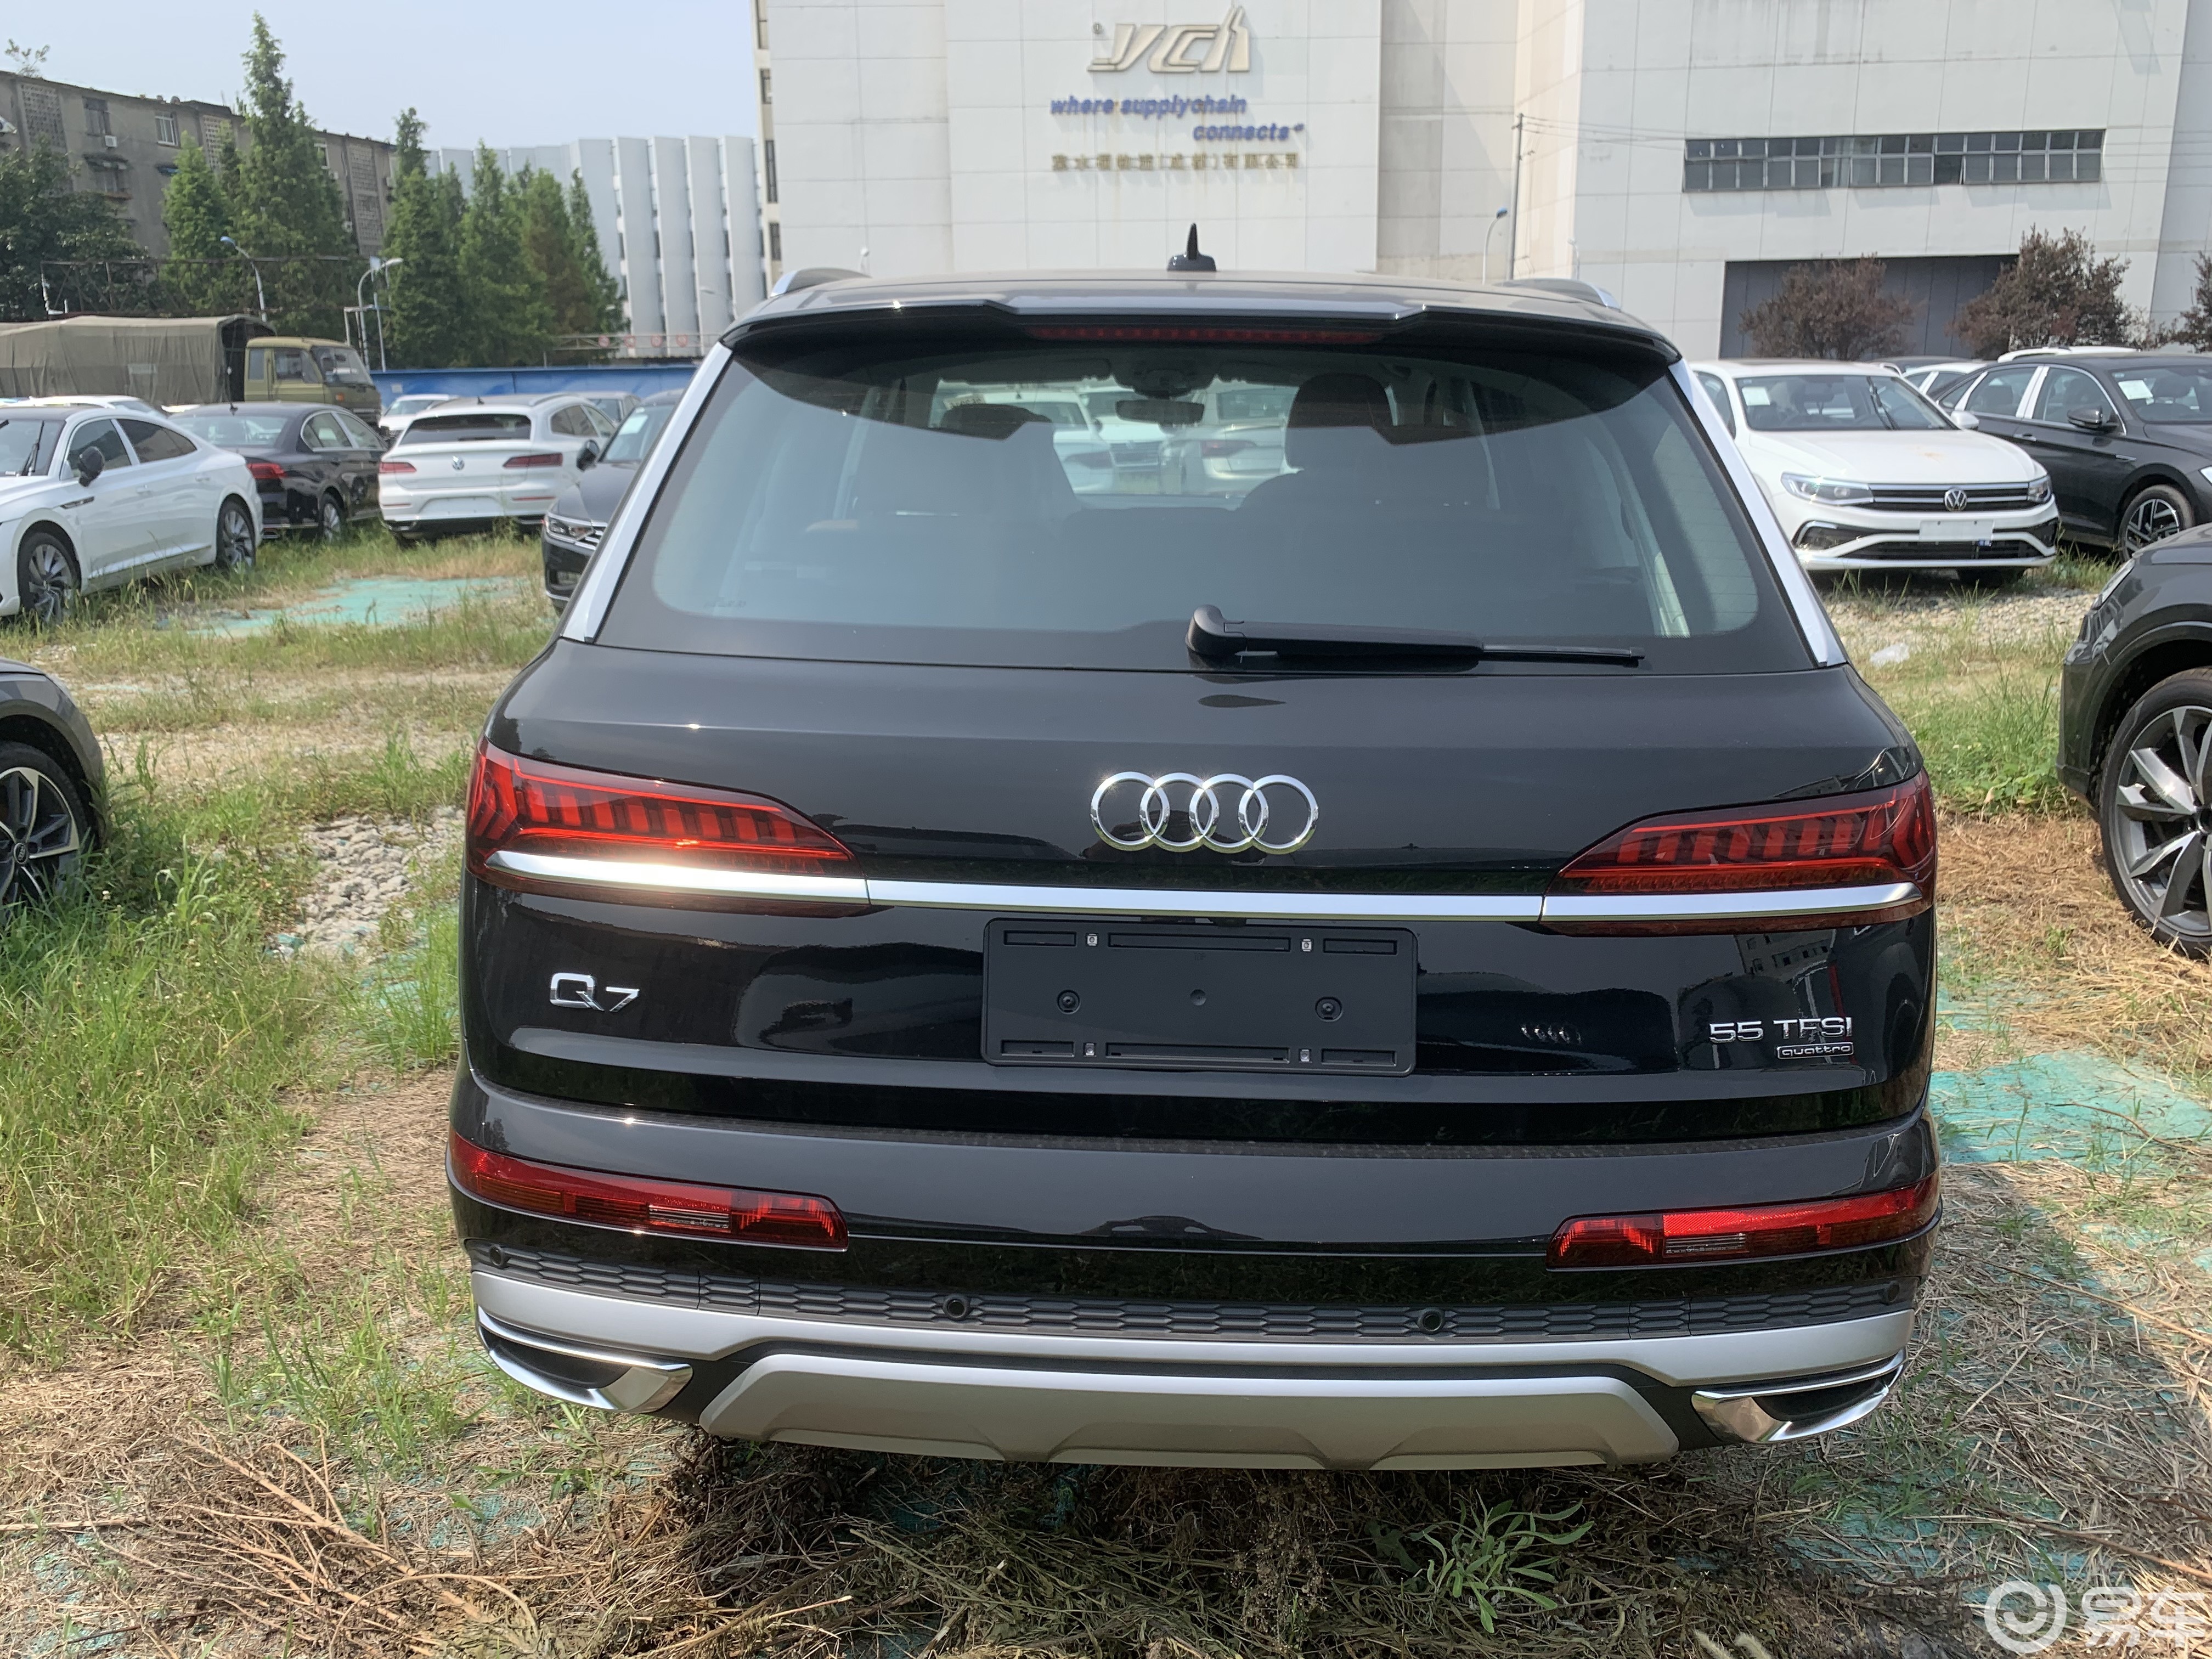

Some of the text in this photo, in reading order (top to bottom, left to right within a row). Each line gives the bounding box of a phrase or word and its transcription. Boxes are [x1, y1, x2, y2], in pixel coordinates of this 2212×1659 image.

[1051, 95, 1114, 114] where
[1193, 123, 1290, 141] connects
[550, 973, 640, 1012] Q7
[1709, 1017, 1852, 1043] 55 TFSI
[1781, 1045, 1851, 1058] quattro
